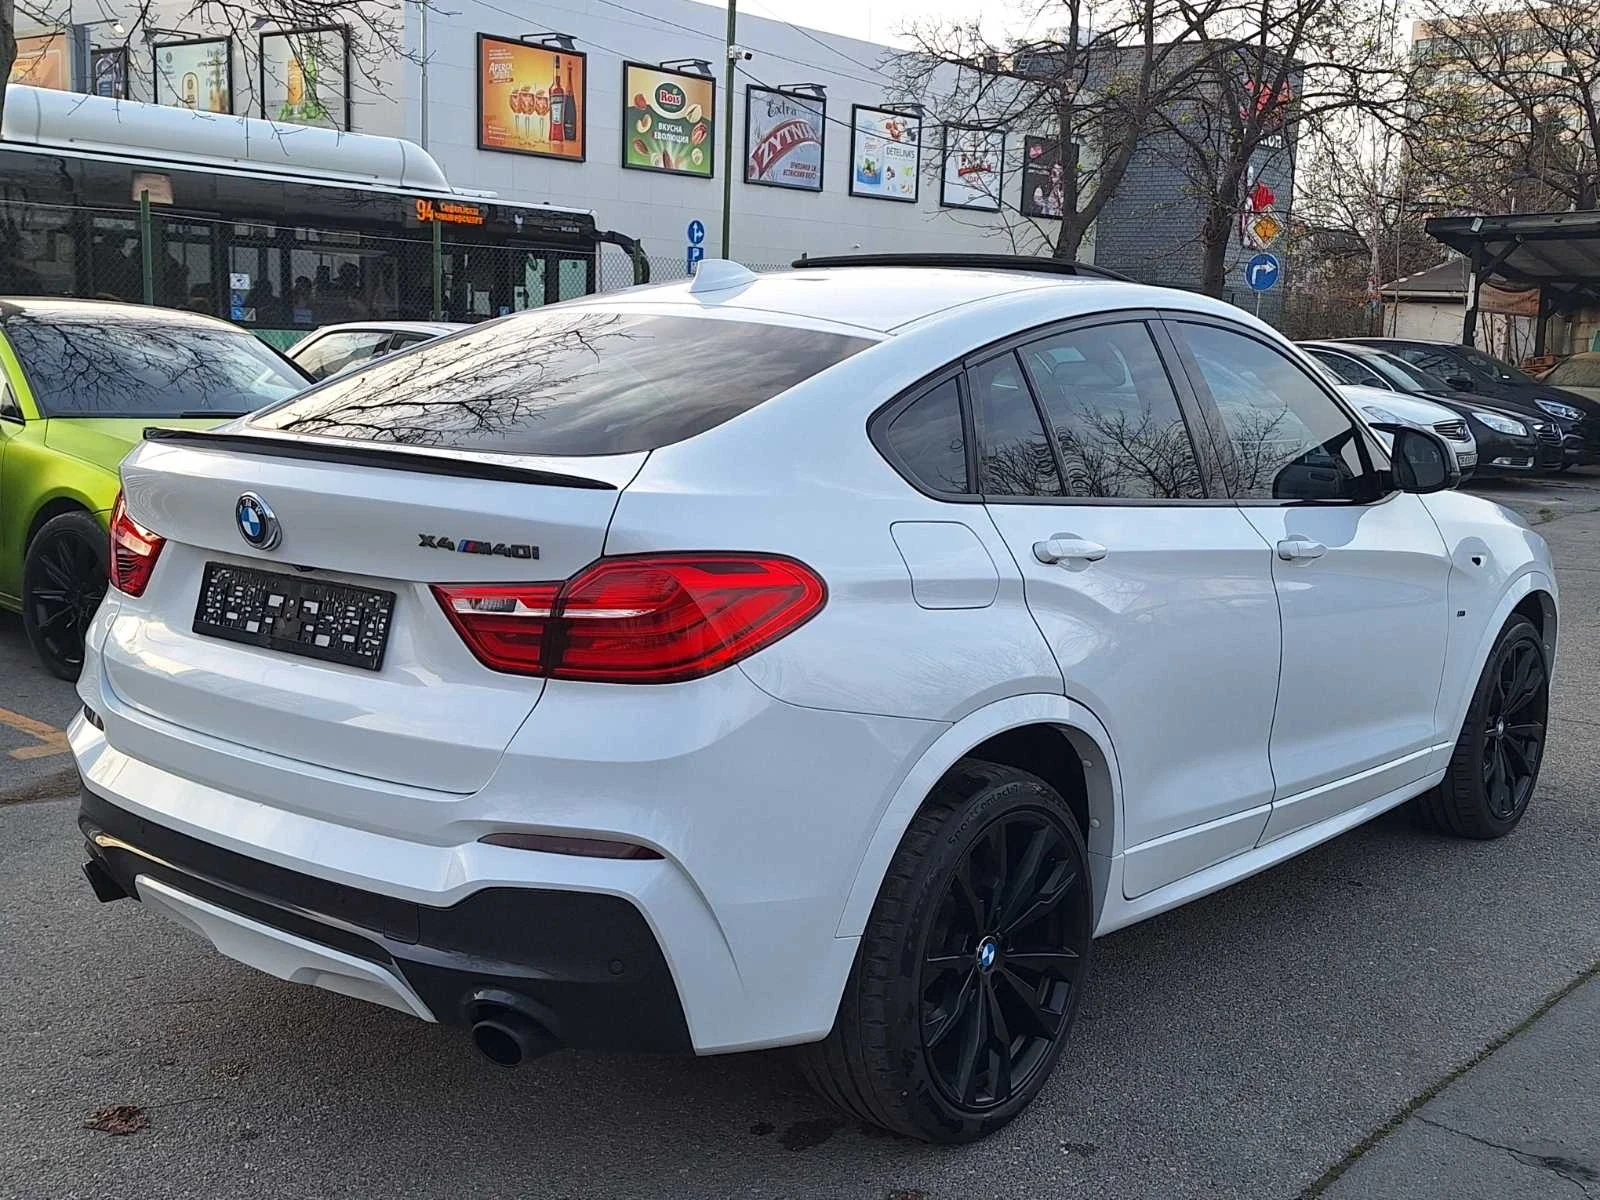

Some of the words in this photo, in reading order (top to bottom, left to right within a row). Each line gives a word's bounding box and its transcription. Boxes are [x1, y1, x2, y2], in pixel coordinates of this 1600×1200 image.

[766, 99, 797, 118] Extra
[658, 122, 683, 133] ВКУСНА
[653, 131, 689, 144] ЕВОЛЮЦИЯ
[415, 198, 434, 222] 94
[692, 247, 700, 261] P
[417, 533, 456, 552] X4
